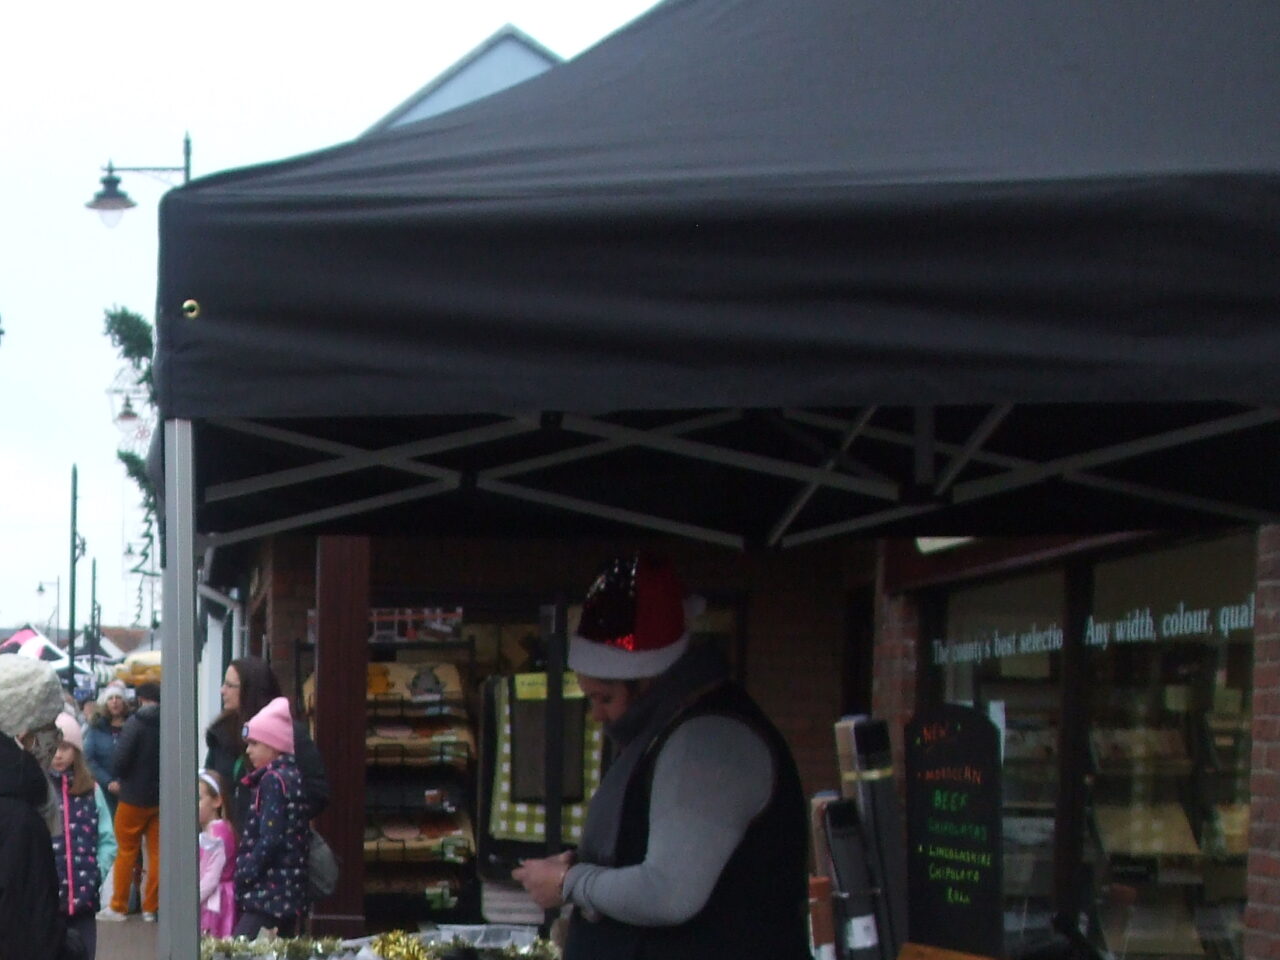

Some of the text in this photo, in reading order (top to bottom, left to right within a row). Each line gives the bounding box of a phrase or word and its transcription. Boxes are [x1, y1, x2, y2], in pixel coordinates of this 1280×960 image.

[994, 628, 1016, 658] best
[1085, 614, 1110, 651] Any
[1162, 600, 1213, 637] colour,
